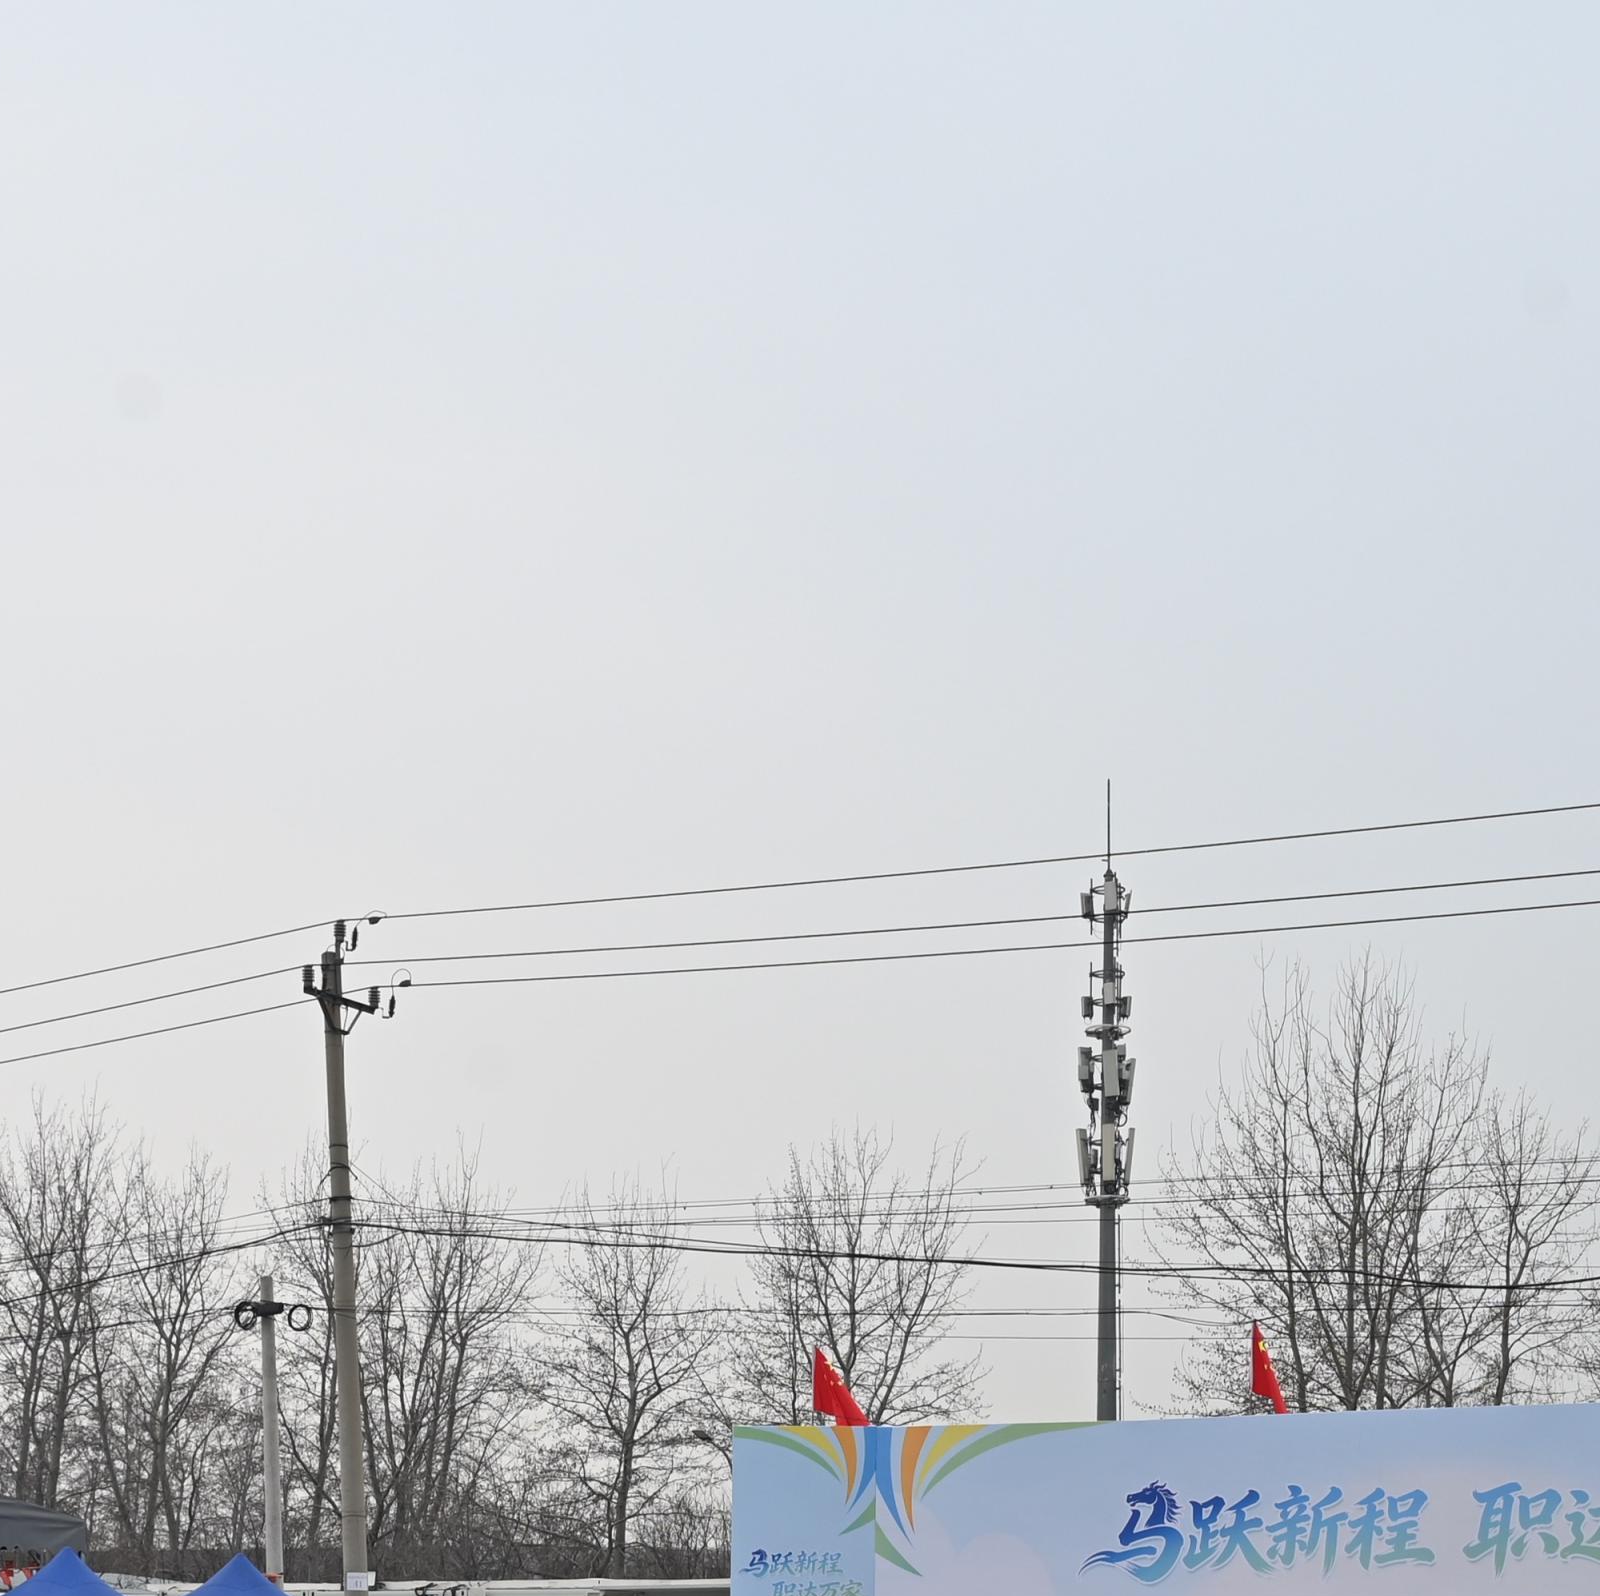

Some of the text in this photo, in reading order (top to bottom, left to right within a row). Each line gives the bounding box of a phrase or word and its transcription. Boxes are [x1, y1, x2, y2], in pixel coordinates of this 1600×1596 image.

[739, 1549, 843, 1577] 马跃新程
[1078, 1480, 1437, 1584] 马跃新程
